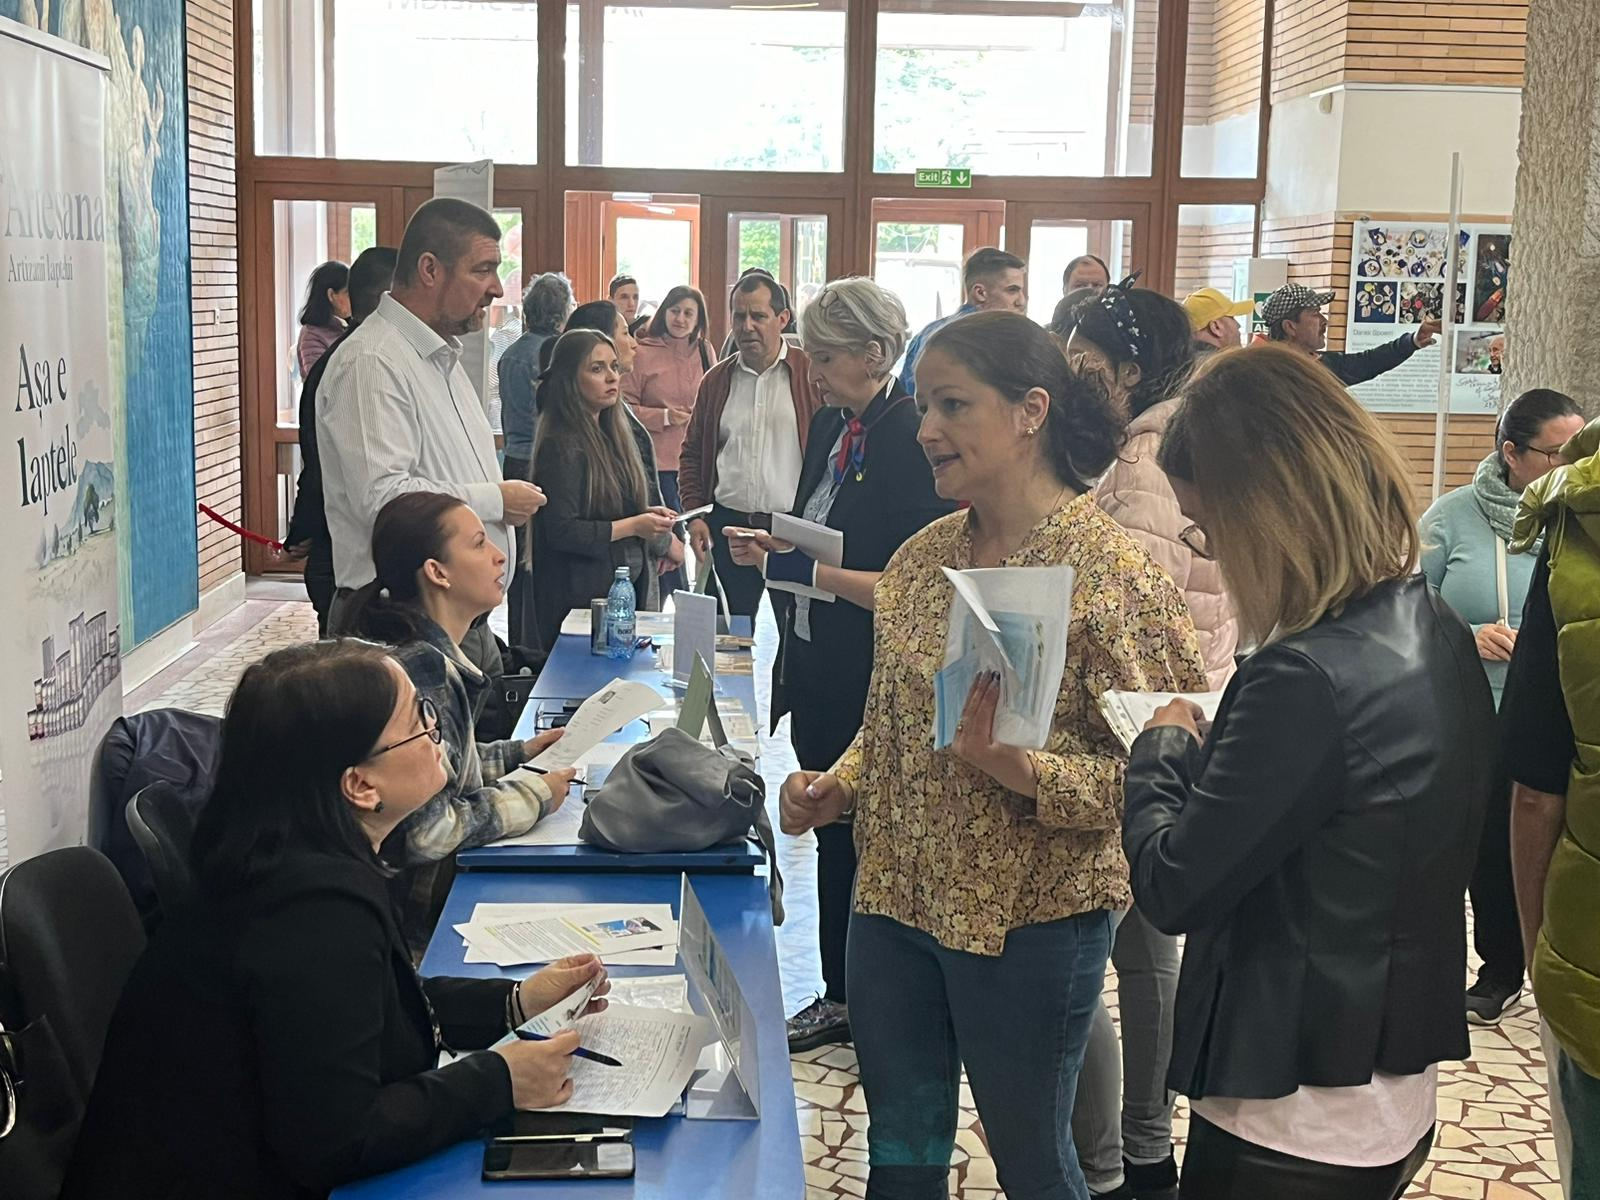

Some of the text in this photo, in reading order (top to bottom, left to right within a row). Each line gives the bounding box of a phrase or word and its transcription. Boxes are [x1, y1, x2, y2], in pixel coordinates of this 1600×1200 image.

[919, 172, 938, 182] Exit
[1253, 323, 1270, 333] AE
[57, 357, 67, 401] e
[17, 424, 78, 517] laptele
